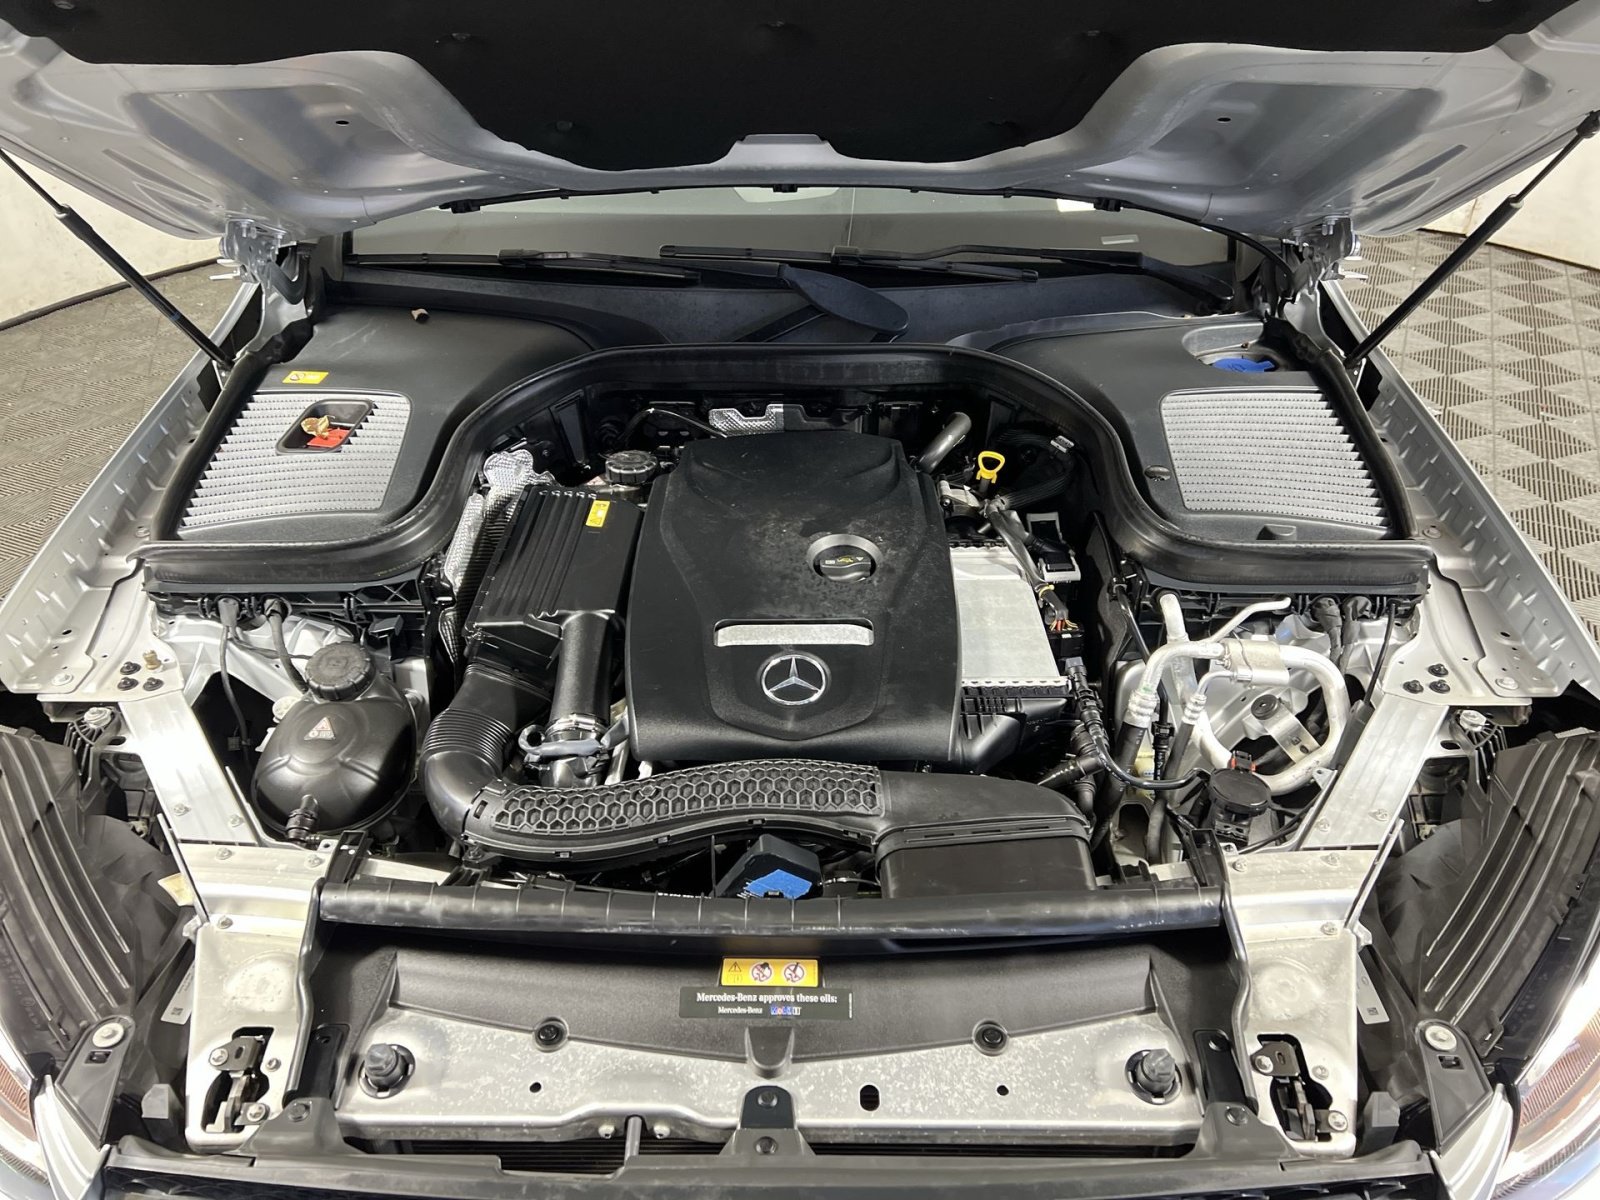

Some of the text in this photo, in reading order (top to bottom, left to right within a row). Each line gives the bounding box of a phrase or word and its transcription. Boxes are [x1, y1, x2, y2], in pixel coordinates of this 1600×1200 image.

[696, 993, 838, 1005] Mercedes-Benz approves these oils:
[717, 1006, 763, 1014] Mercedes-Benz
